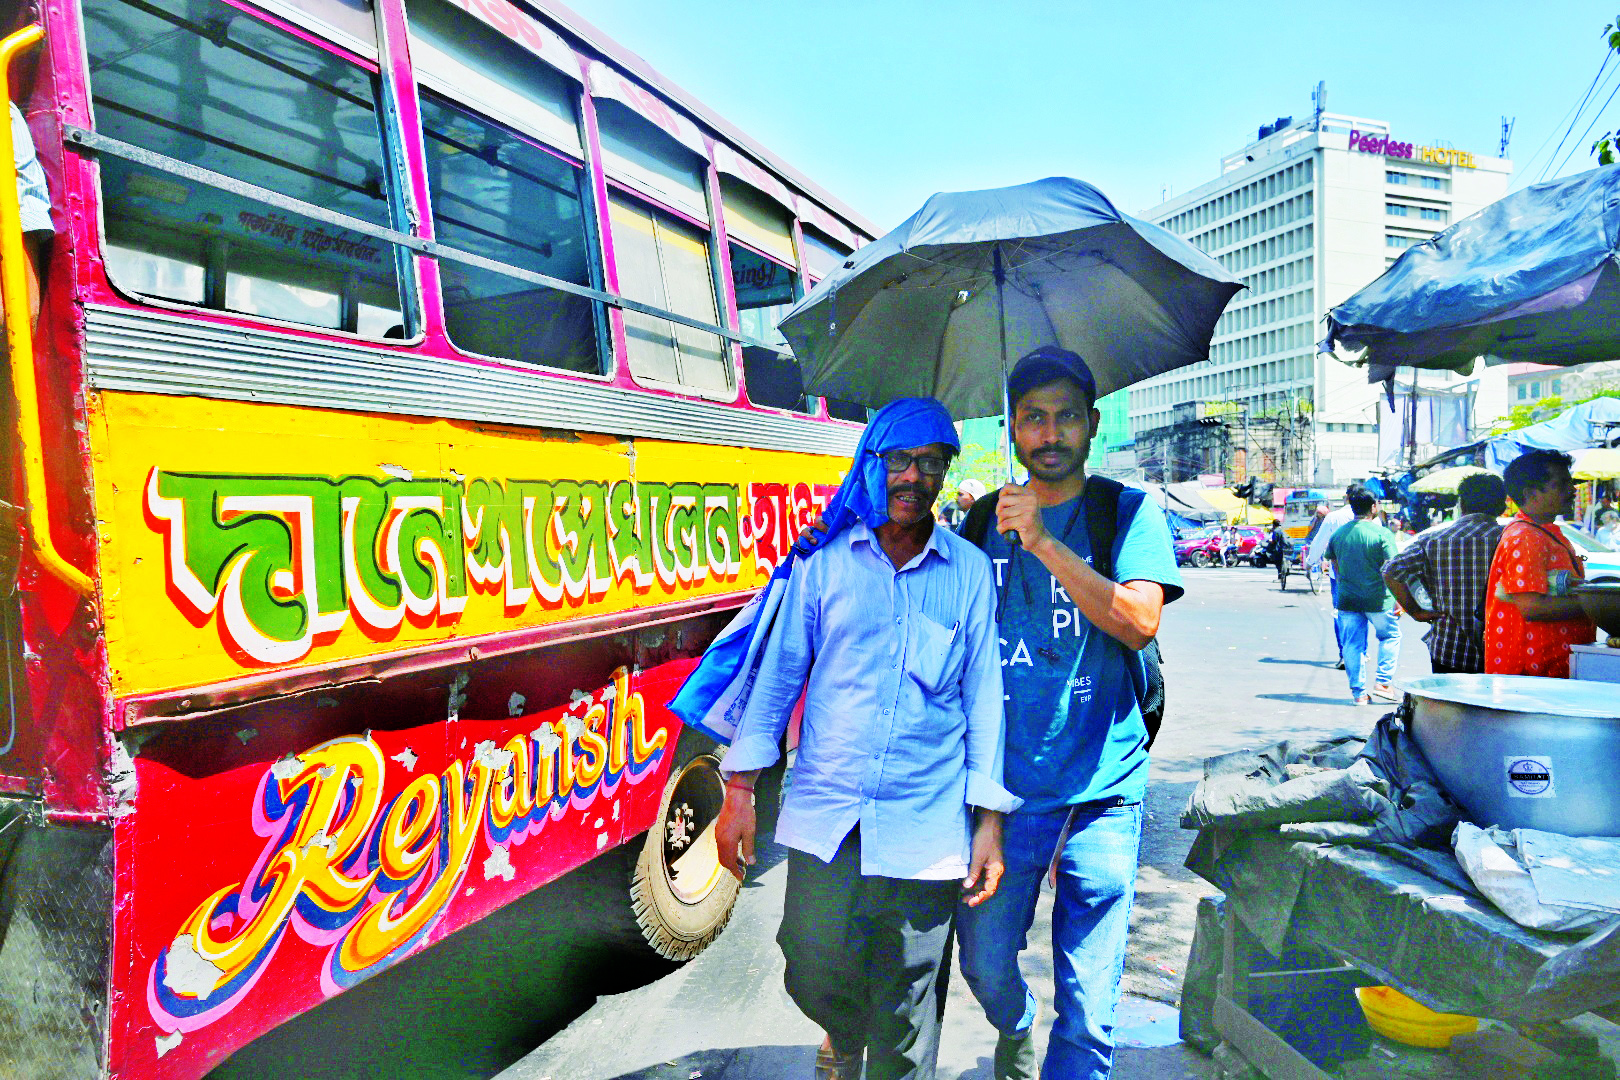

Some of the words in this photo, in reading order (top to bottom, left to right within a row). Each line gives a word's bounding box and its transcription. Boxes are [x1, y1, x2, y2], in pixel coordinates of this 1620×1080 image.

[1349, 129, 1413, 159] Peerless
[1422, 145, 1477, 169] HOTEL
[993, 558, 1009, 587] T
[1052, 608, 1081, 639] PI
[1066, 676, 1092, 688] VIBES
[150, 664, 668, 1022] Reyansh
